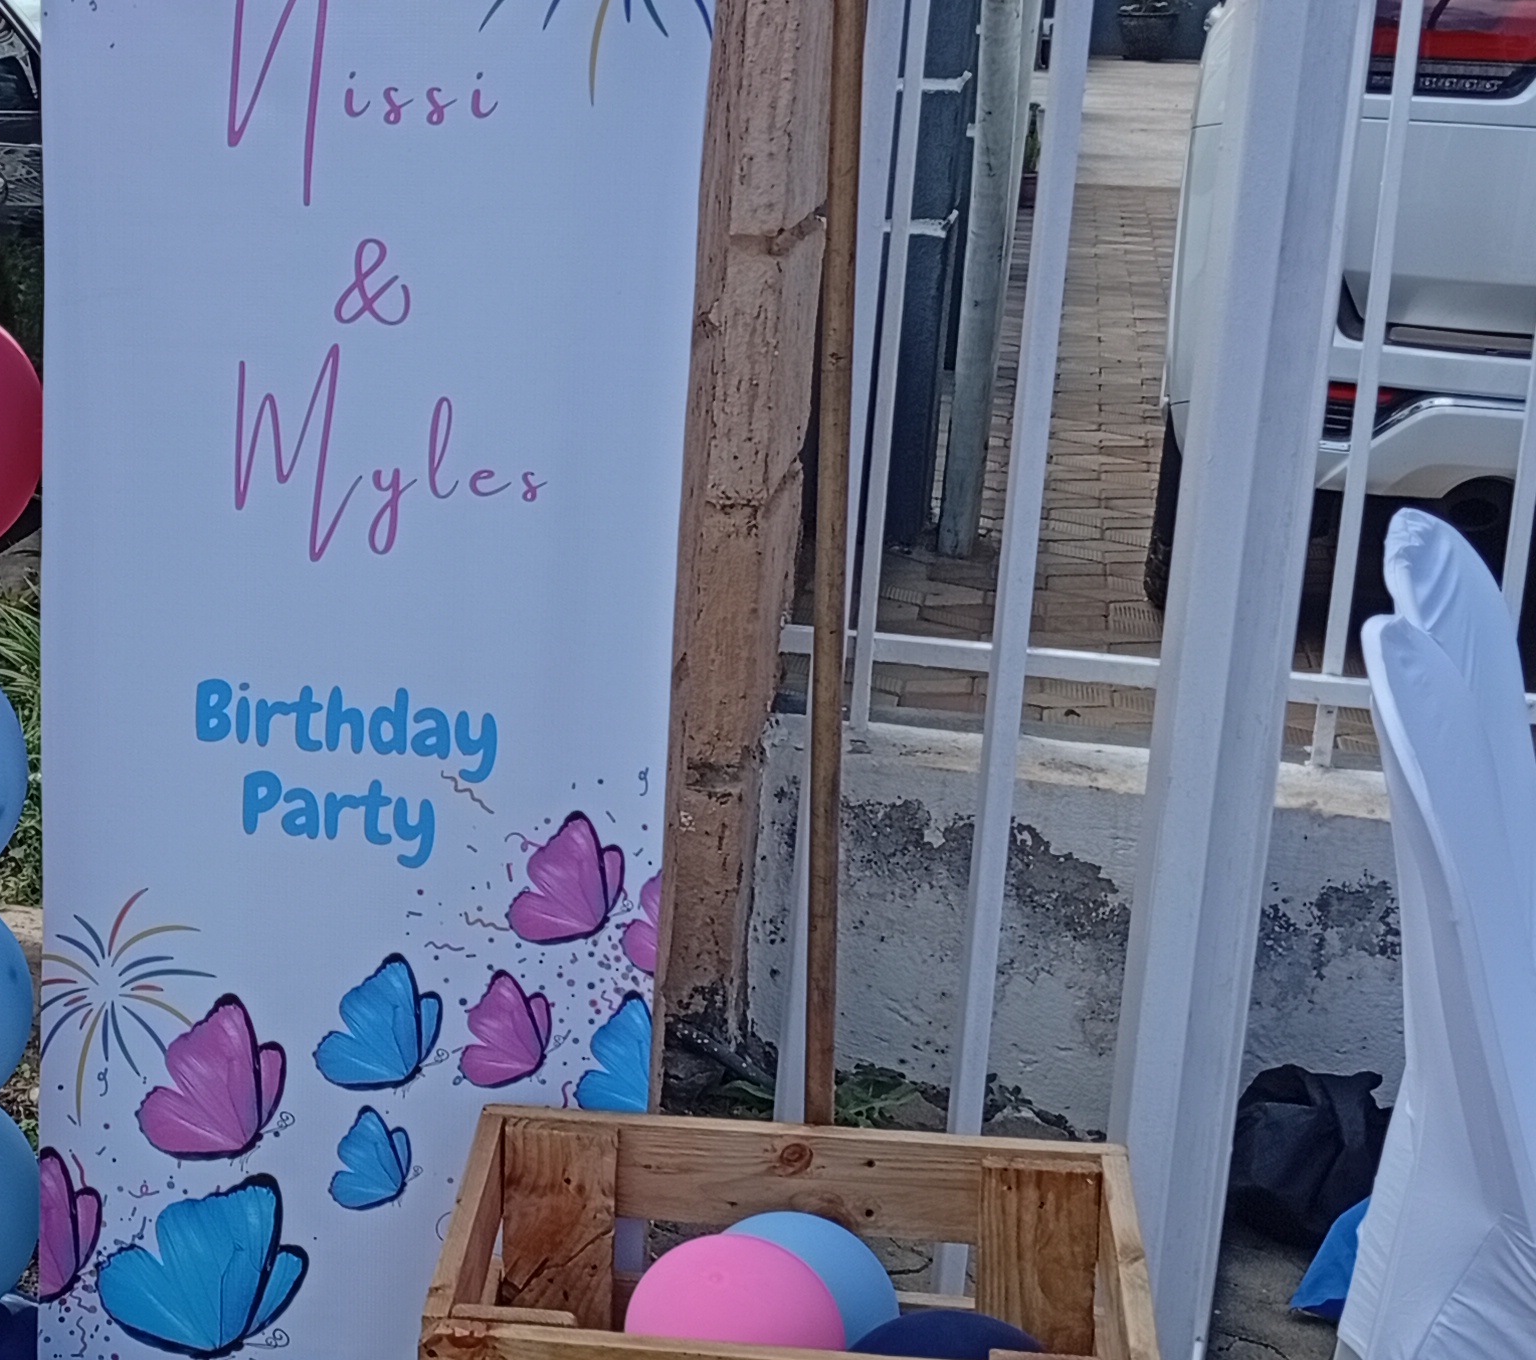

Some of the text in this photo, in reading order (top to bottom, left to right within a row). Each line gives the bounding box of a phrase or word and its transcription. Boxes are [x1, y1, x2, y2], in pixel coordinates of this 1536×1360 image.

[333, 237, 411, 326] &
[234, 342, 548, 562] Myles
[194, 678, 498, 783] Birthday
[241, 771, 436, 868] Party
